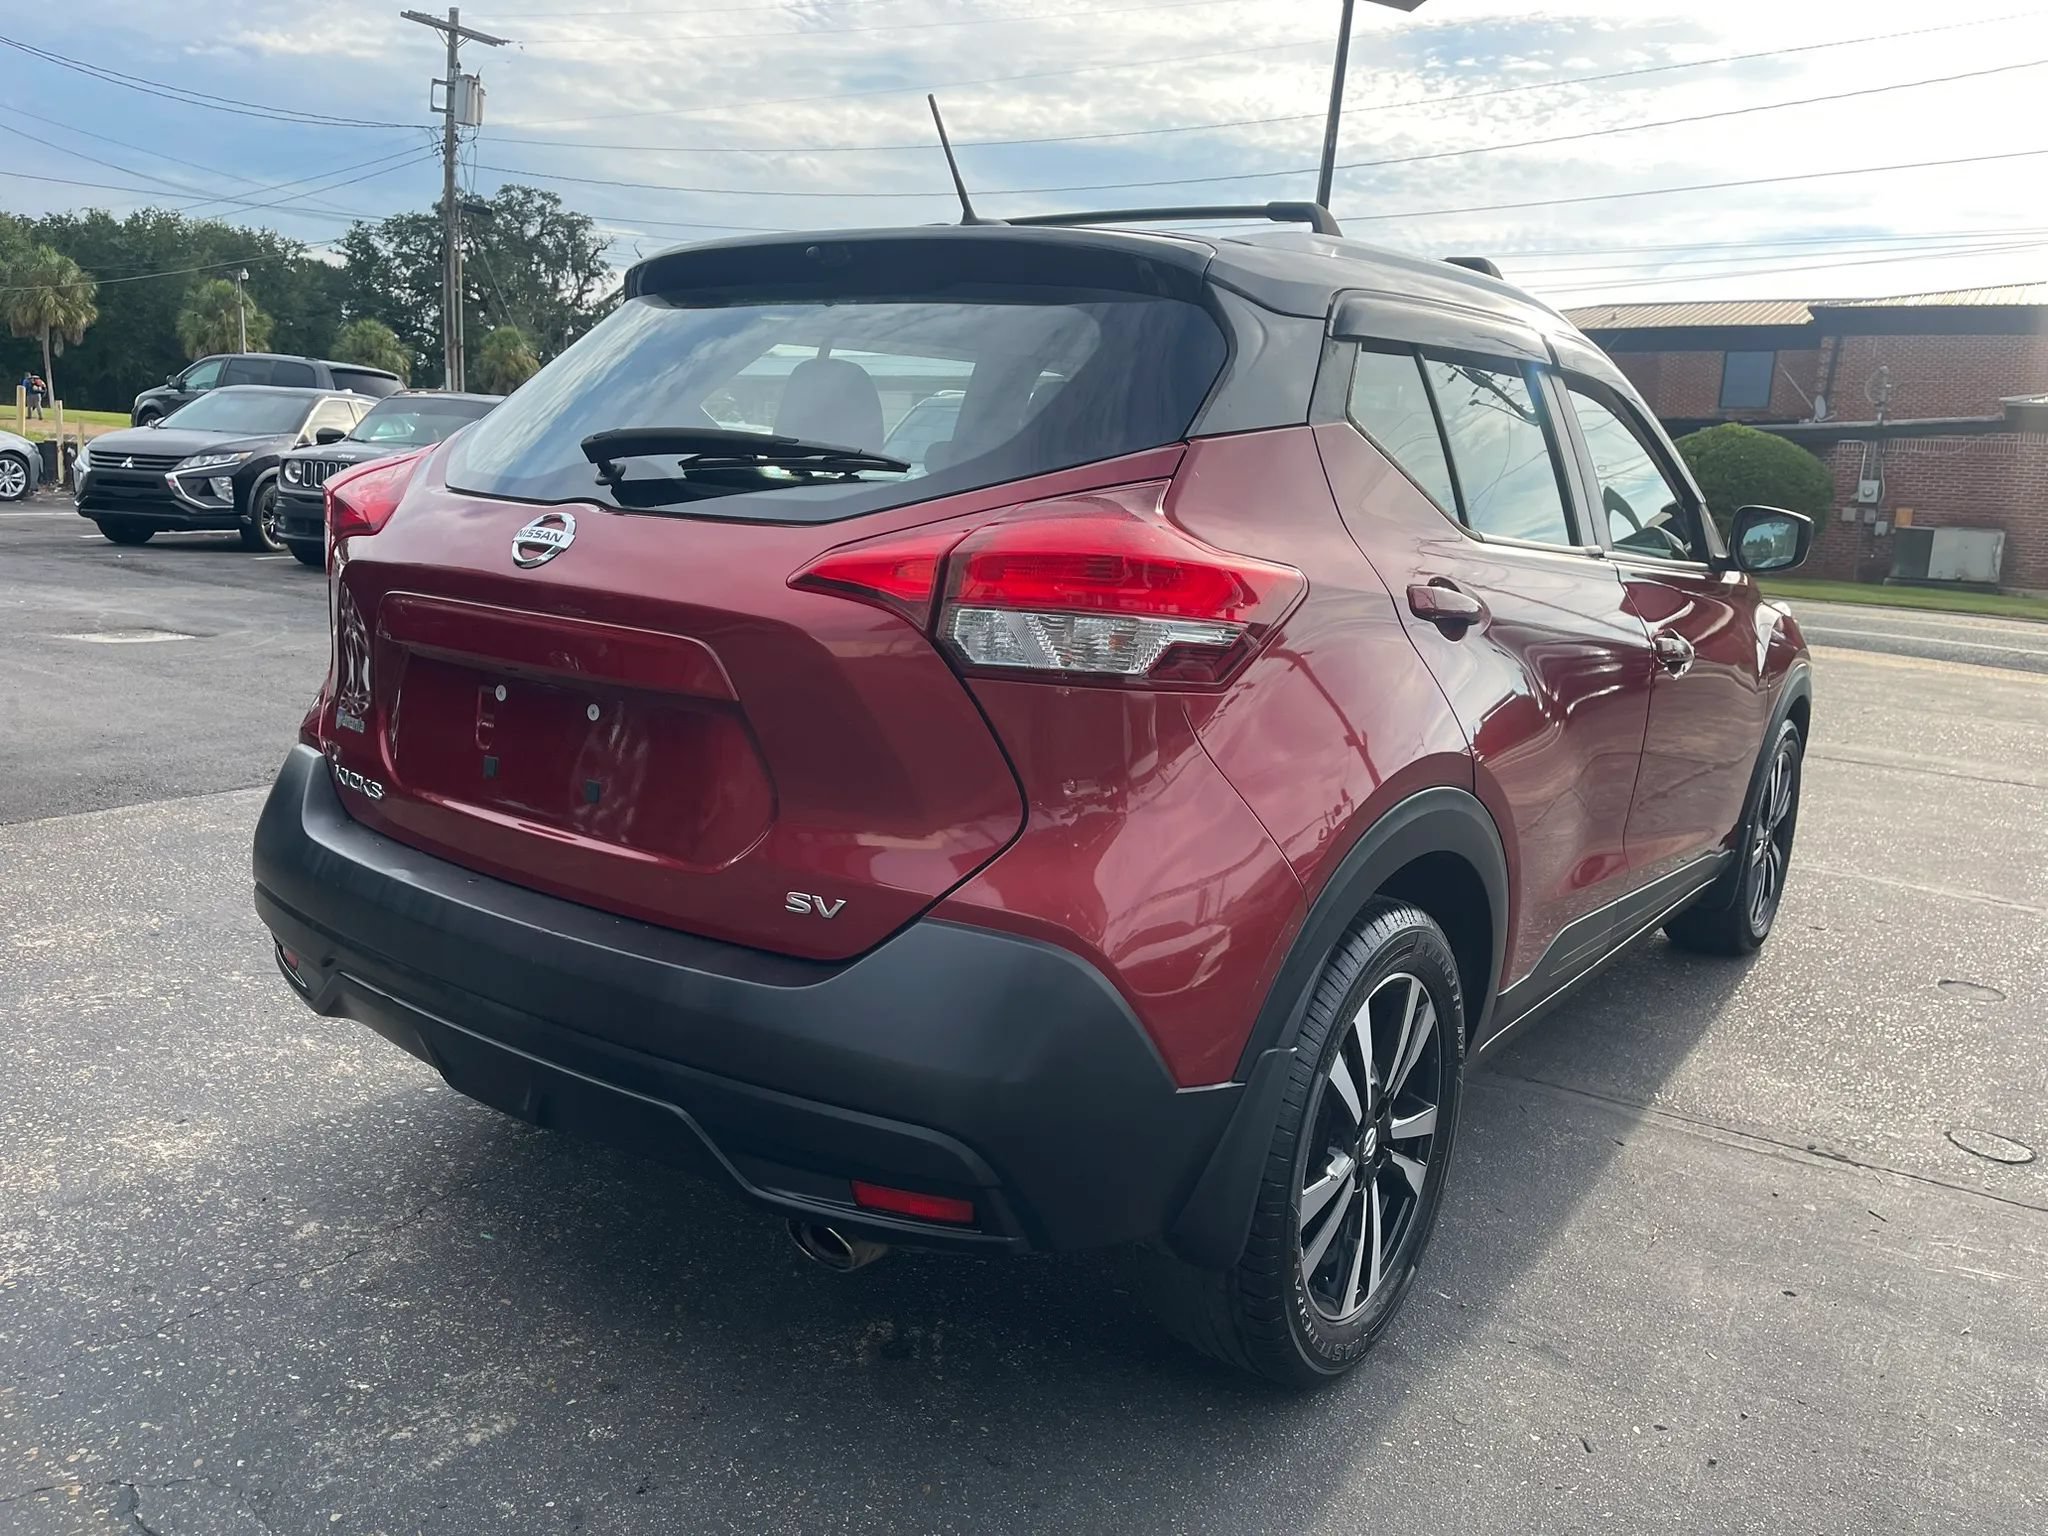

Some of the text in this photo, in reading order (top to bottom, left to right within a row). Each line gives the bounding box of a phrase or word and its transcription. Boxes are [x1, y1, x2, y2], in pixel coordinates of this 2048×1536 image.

[519, 529, 563, 543] NISSAN
[335, 764, 384, 799] KICKS
[785, 891, 847, 919] SV
